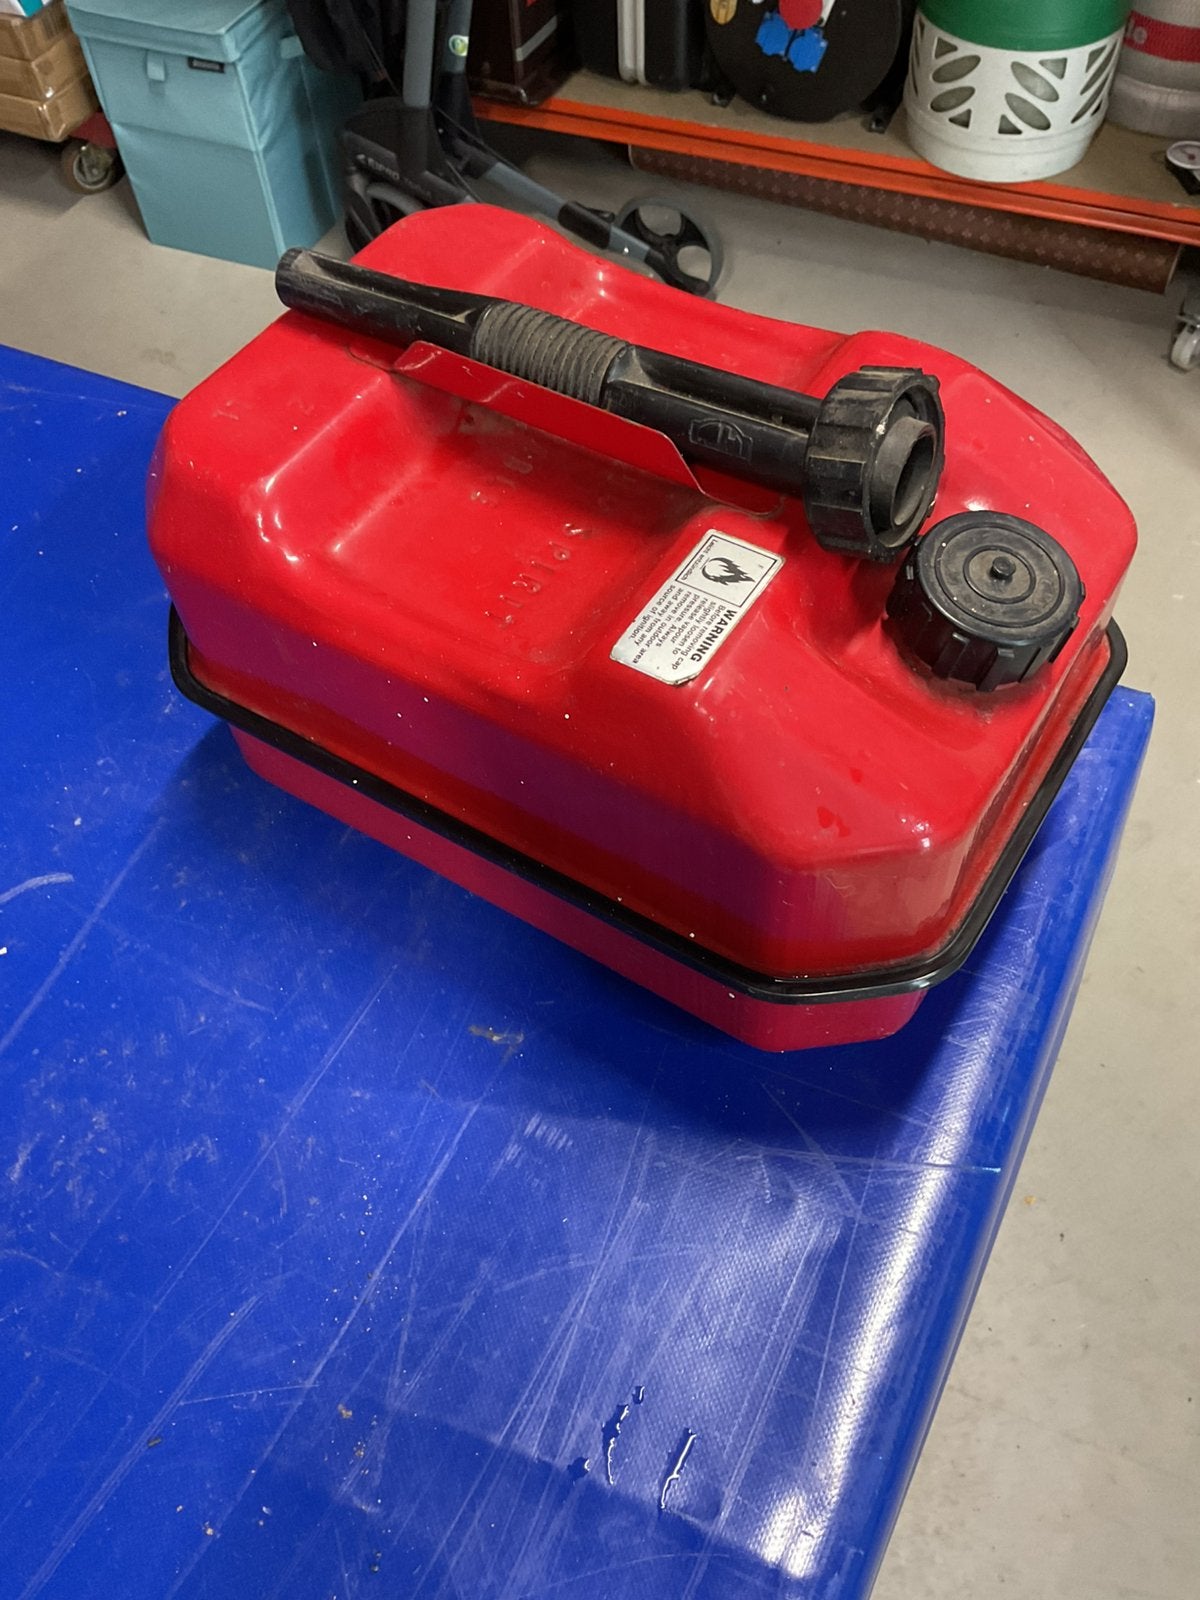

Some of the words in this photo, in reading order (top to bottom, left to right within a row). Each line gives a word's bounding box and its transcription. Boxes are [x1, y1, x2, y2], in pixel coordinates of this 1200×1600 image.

[655, 584, 675, 606] source
[670, 590, 692, 614] remove
[671, 587, 684, 601] and
[649, 606, 658, 614] of
[656, 600, 673, 617] away
[674, 593, 700, 622] pressure.
[687, 597, 708, 620] release
[694, 600, 716, 624] slightly
[705, 604, 726, 625] Before
[628, 613, 652, 639] ignition.
[644, 617, 661, 633] from
[644, 621, 667, 648] outdoor
[655, 623, 677, 647] Always
[670, 621, 690, 643] vapour
[678, 624, 699, 646] loosen
[689, 609, 737, 662] WARNING
[633, 633, 647, 646] any
[679, 625, 708, 656] removing
[632, 647, 646, 663] area
[671, 647, 681, 655] to
[671, 656, 683, 670] cap
